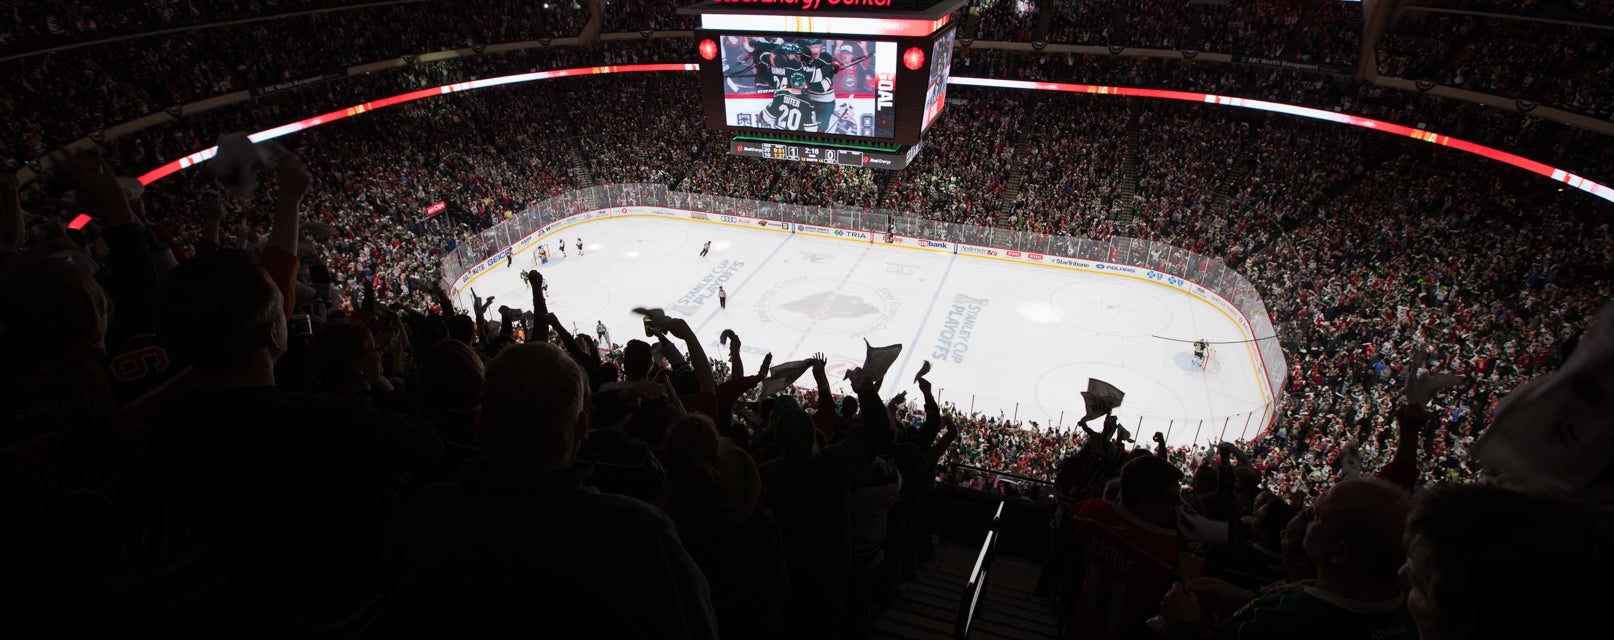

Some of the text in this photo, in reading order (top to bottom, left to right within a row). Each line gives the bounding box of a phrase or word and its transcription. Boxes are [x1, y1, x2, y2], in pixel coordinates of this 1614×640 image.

[783, 95, 800, 108] SUTER
[878, 73, 893, 111] GOAL
[777, 104, 802, 131] 20
[847, 231, 867, 239] TRIA
[678, 259, 729, 305] STANLEY CUP
[692, 260, 745, 305] PLAYOFFS
[1106, 265, 1136, 274] POLARIS
[932, 304, 966, 361] PLAYOFFS
[952, 304, 981, 364] STANLEY CUP
